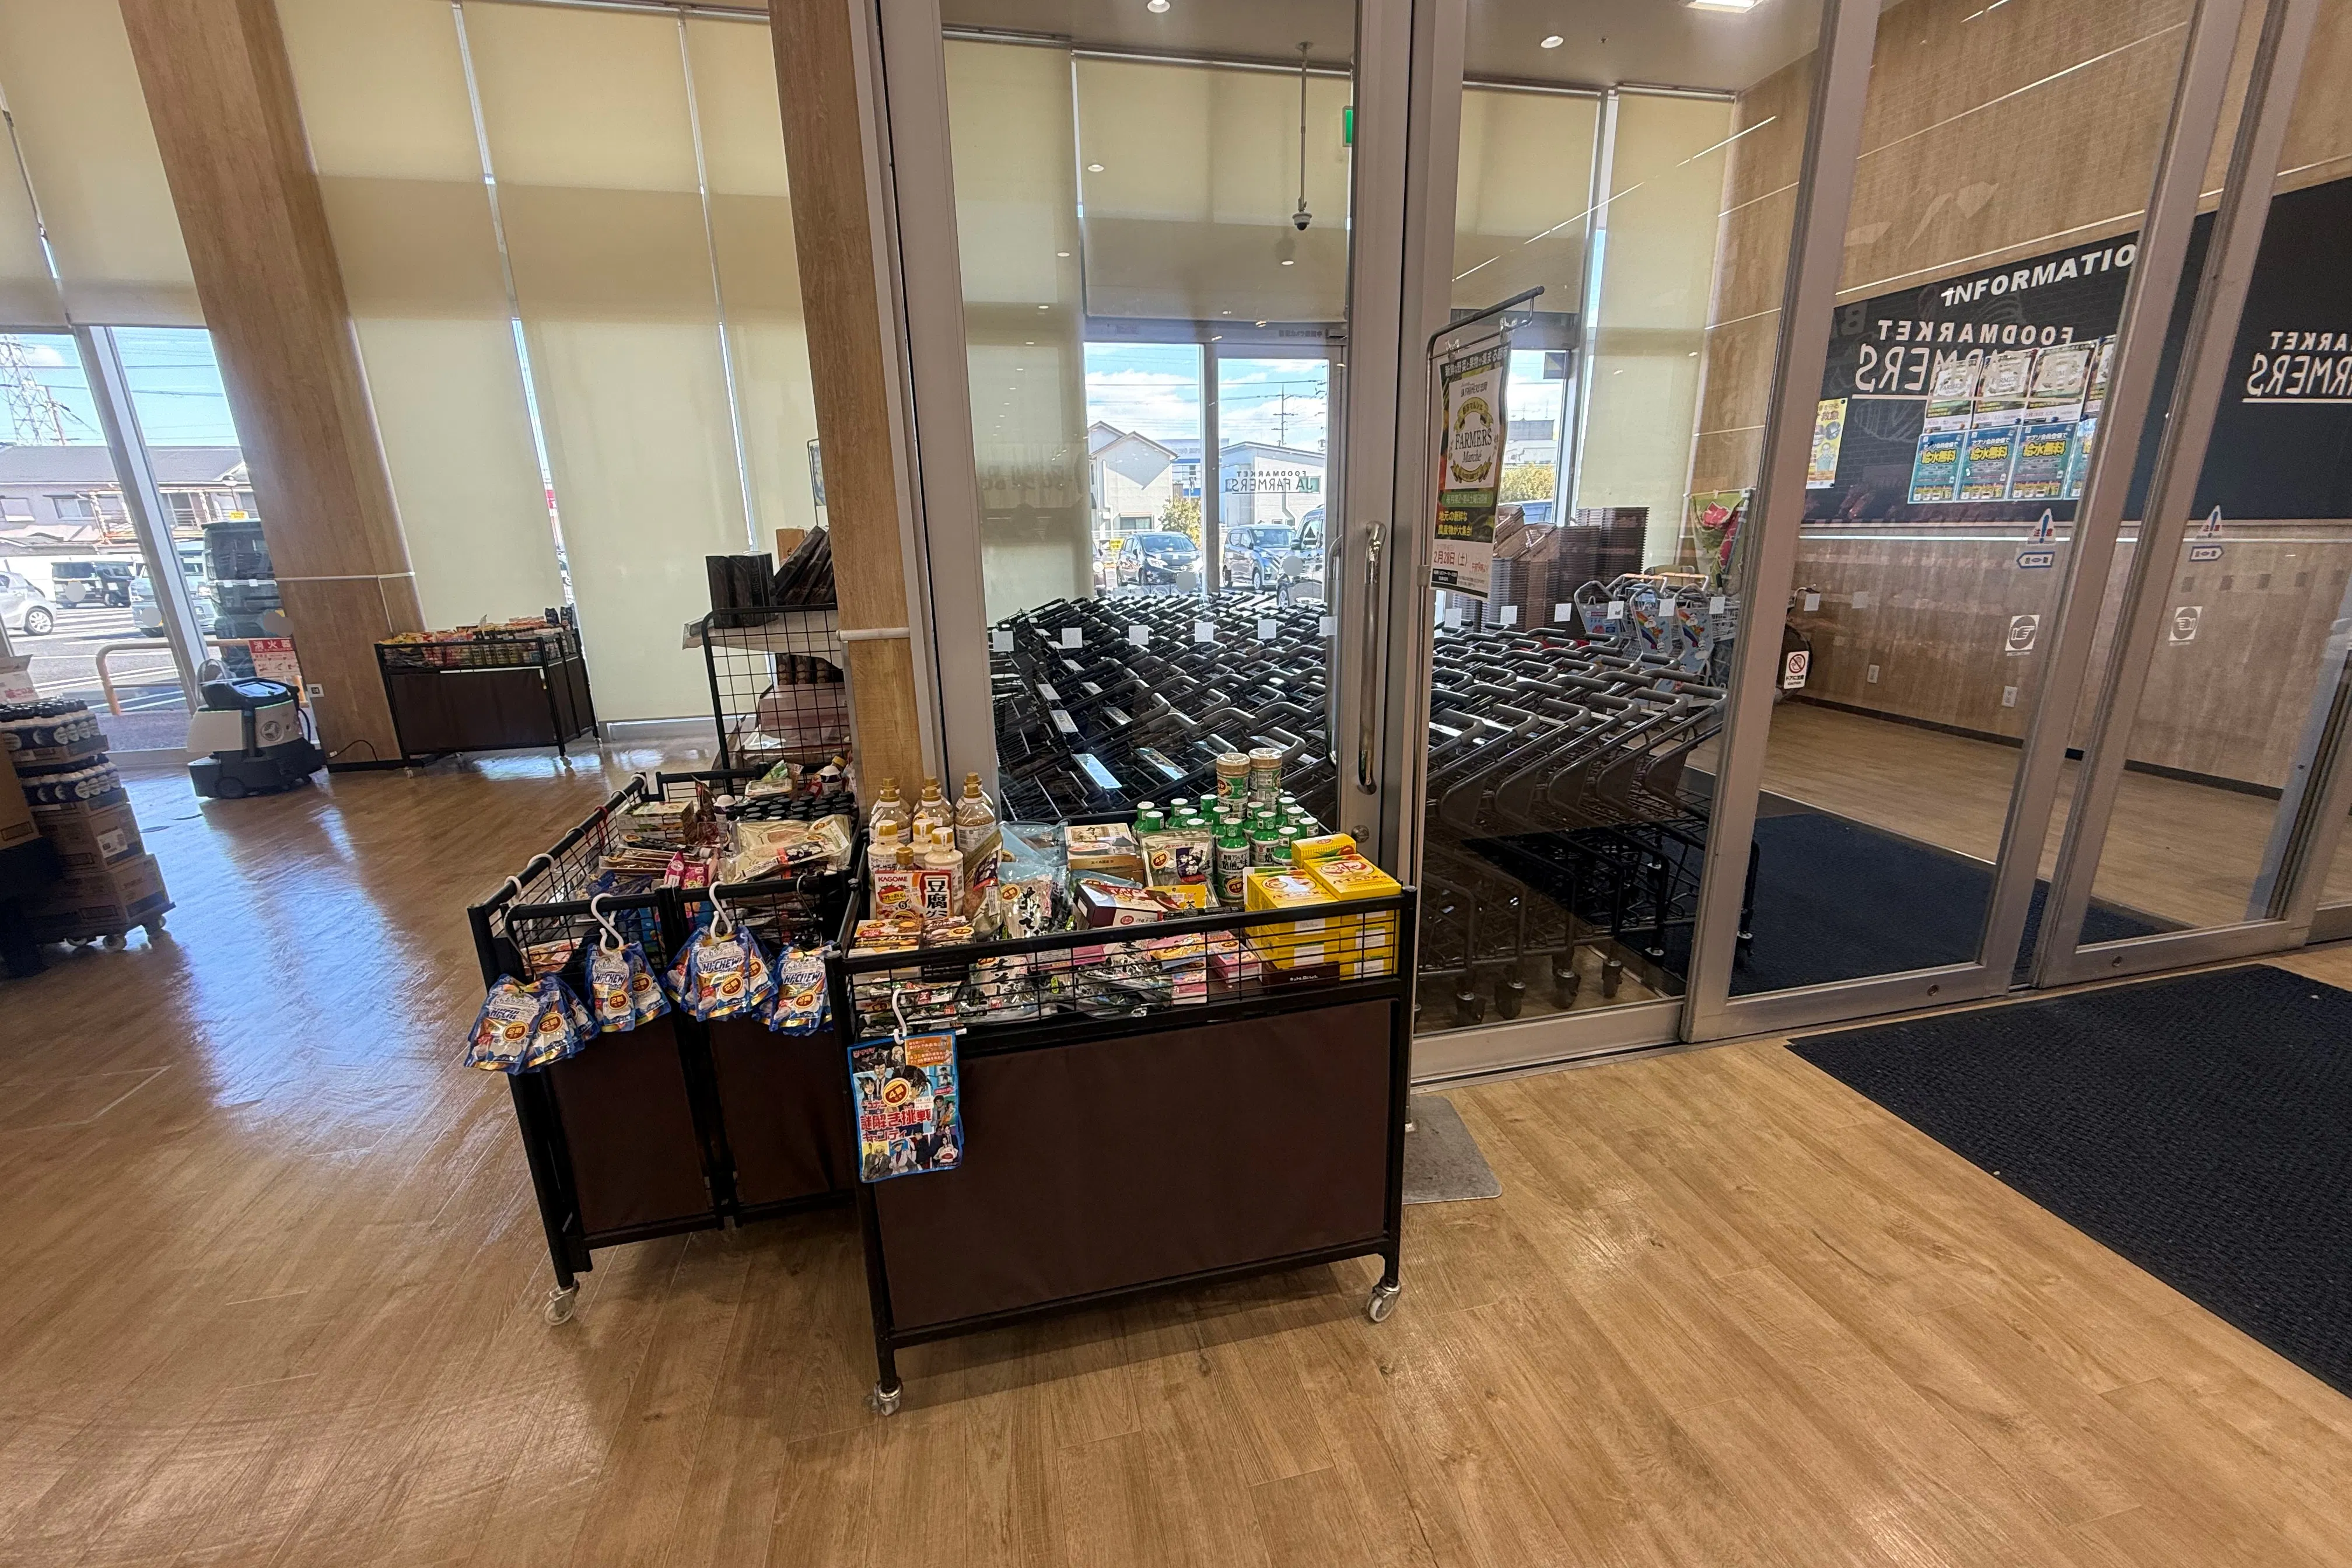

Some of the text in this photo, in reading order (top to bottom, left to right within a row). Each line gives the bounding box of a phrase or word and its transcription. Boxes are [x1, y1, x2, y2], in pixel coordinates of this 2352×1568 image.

[1455, 428, 1492, 450] FARMERS
[1462, 450, 1482, 463] Marché
[253, 639, 291, 649] 消火器
[927, 877, 947, 909] 豆腐
[702, 956, 744, 974] HI-CHEW
[594, 972, 626, 984] HI-CHEW
[783, 972, 822, 986] HI-CHEW
[860, 1108, 932, 1130] 謎解き挑戦
[862, 1129, 907, 1143] キャンディ
